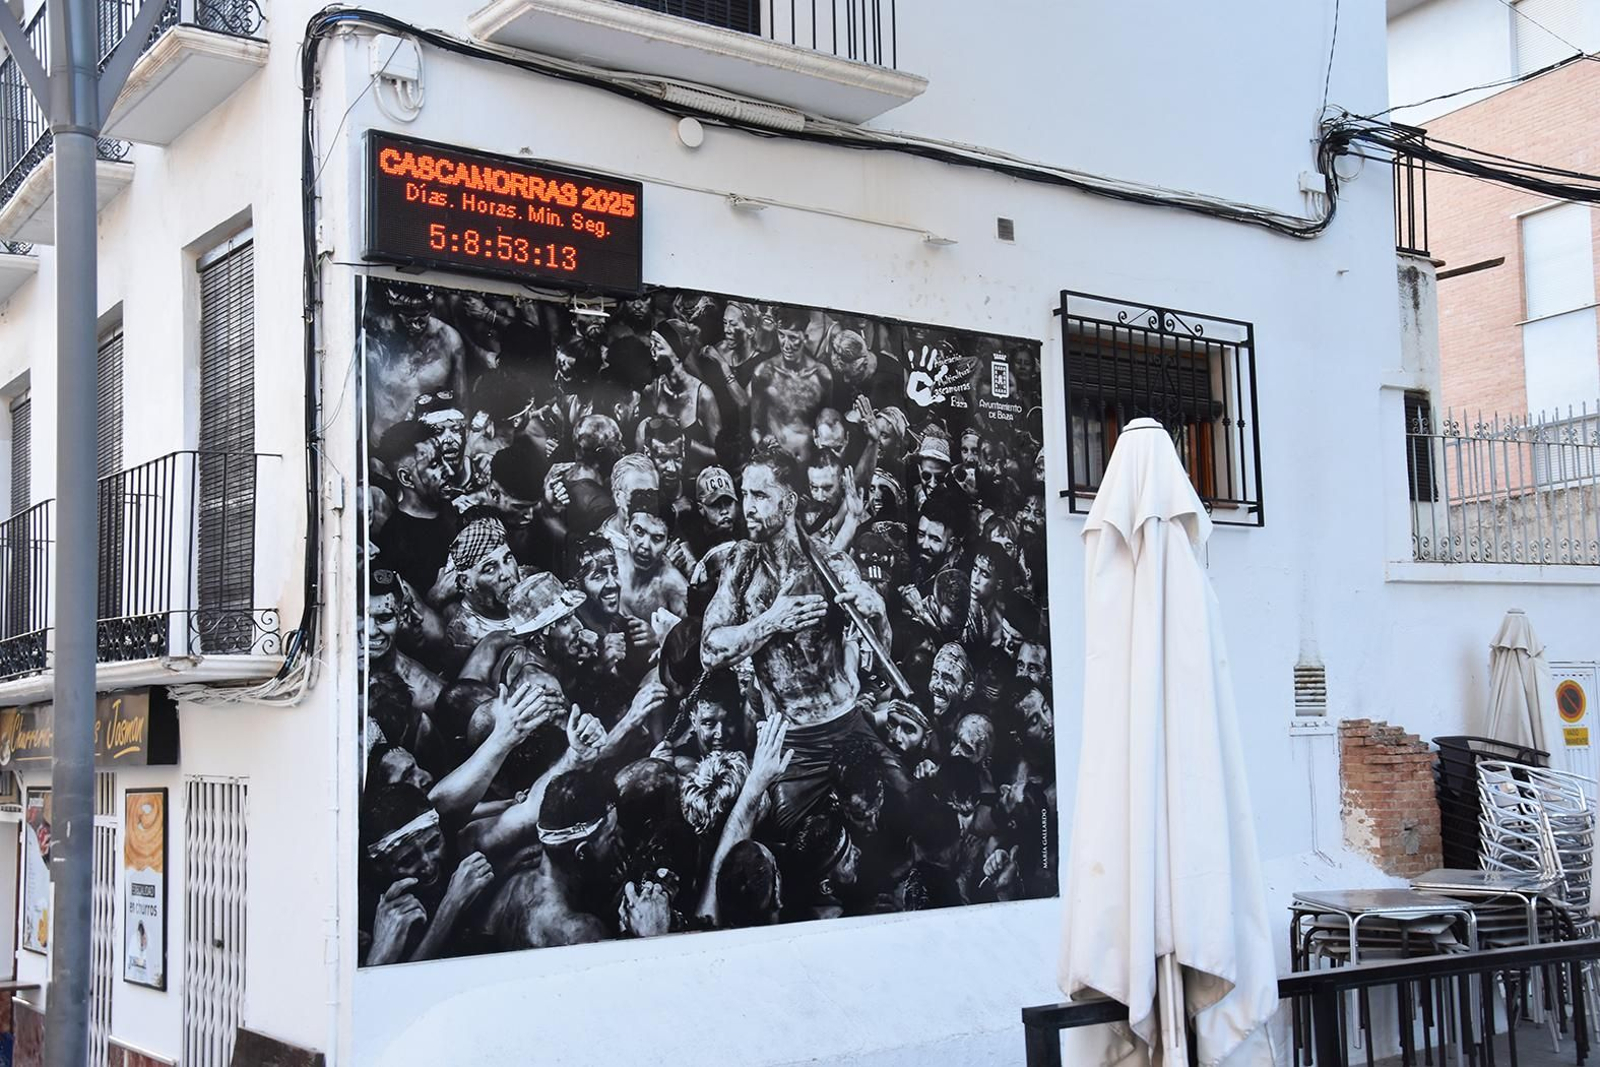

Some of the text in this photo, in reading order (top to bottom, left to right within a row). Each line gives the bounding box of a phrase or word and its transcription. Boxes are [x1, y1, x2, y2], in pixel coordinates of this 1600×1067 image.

[380, 148, 635, 218] CASCAMORRAS 2025
[405, 182, 612, 239] Días. Horas. Min. Seg.
[429, 223, 577, 271] 5:8:53:13
